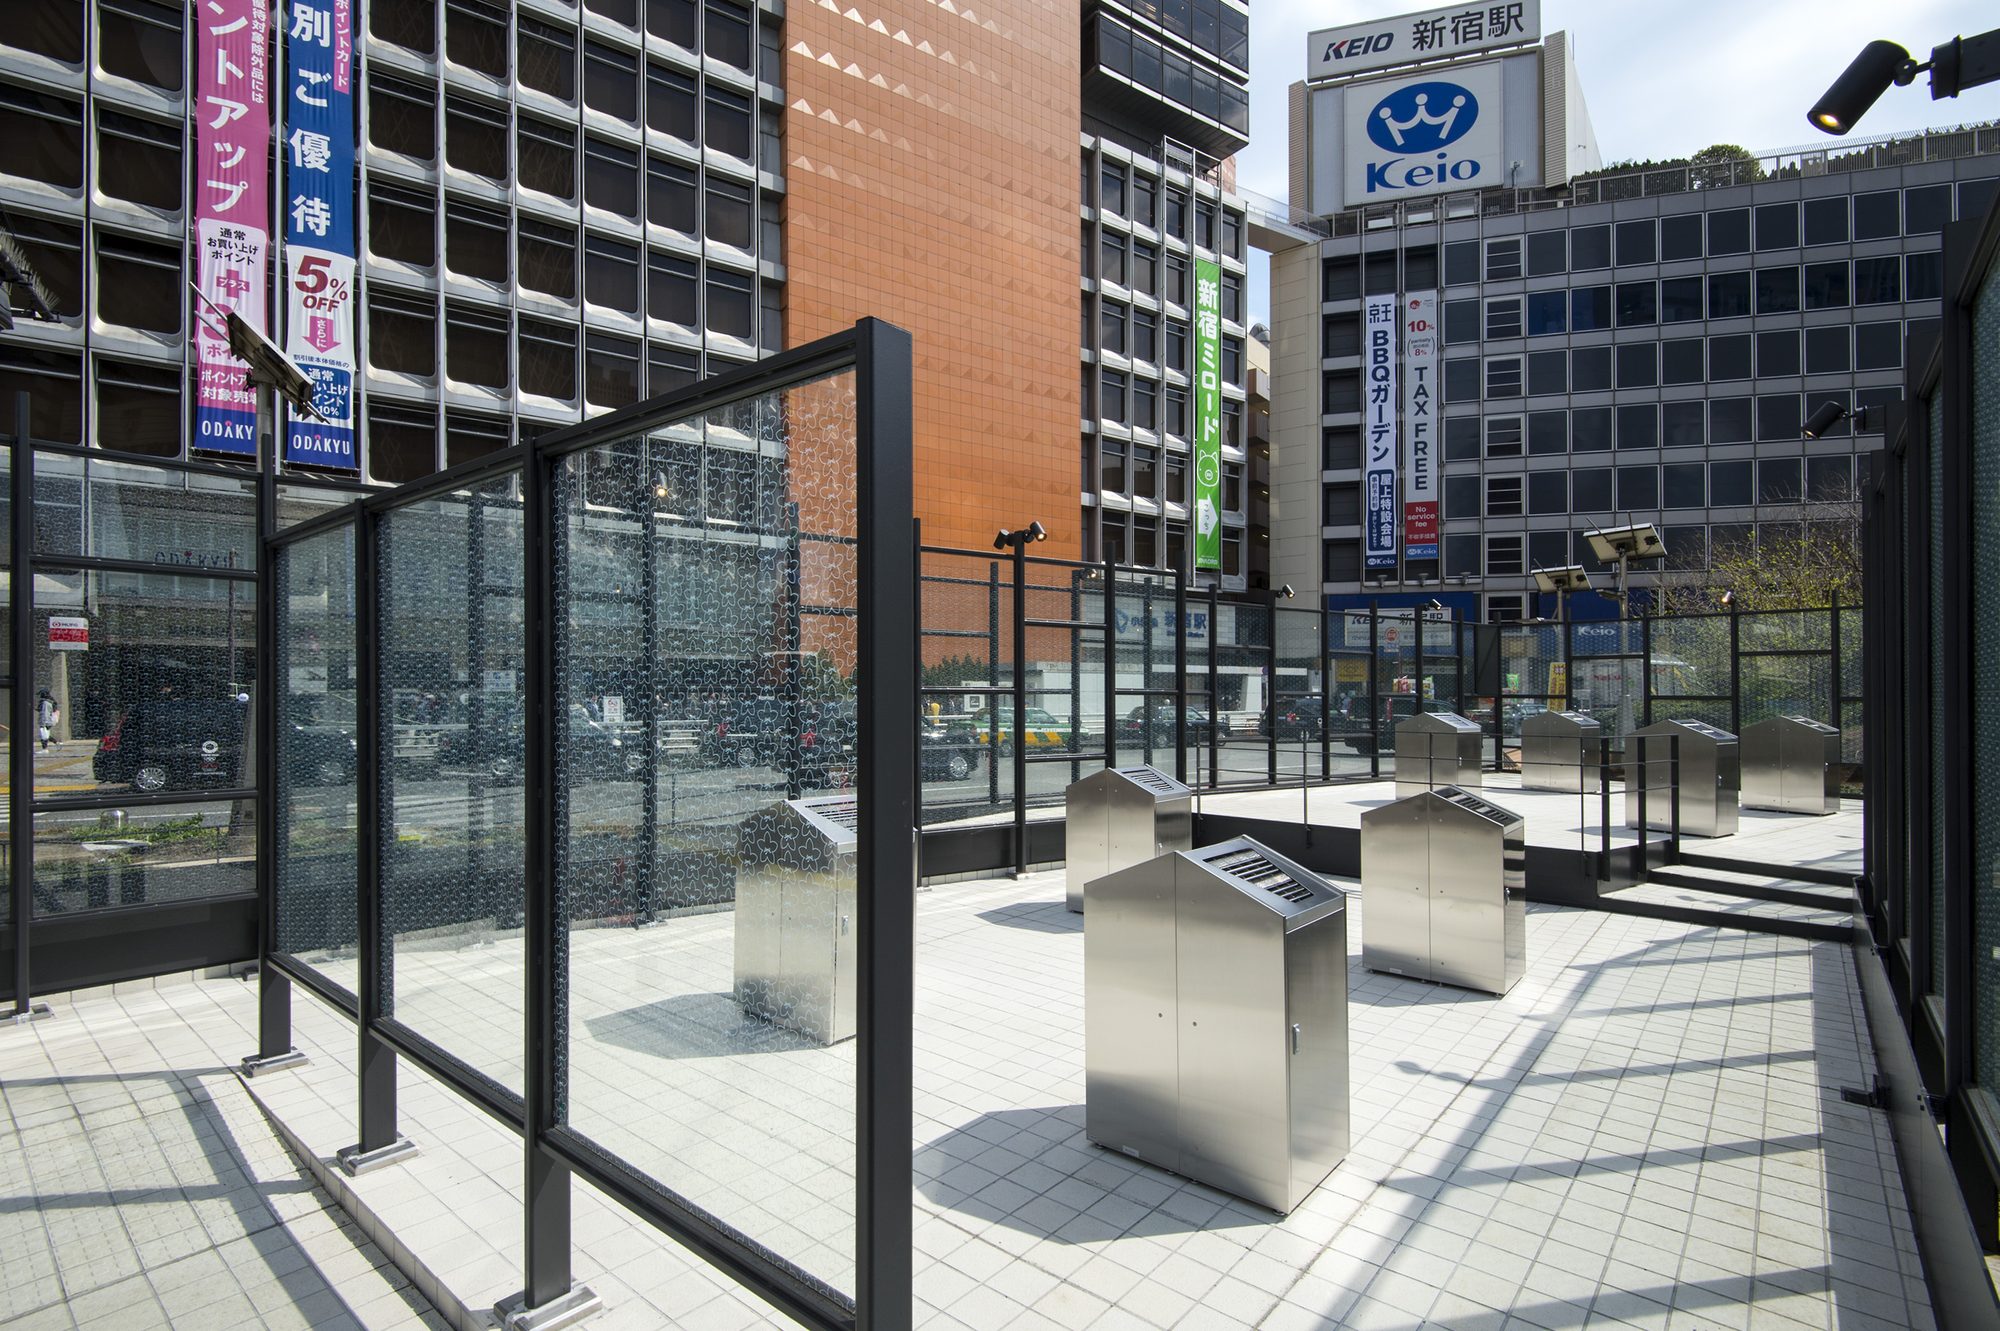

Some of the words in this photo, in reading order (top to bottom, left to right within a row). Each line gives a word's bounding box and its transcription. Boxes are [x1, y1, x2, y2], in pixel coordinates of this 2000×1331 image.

[1323, 32, 1394, 62] KEIO
[1413, 2, 1524, 51] 新宿駅
[206, 0, 249, 213] ントアップ
[289, 2, 332, 236] 別ご優待
[1366, 152, 1481, 193] Keio
[219, 226, 247, 241] 通常
[207, 236, 260, 255] お買い上げ
[211, 249, 255, 266] ポイント
[218, 278, 247, 290] プラス
[294, 255, 349, 302] 5%
[302, 295, 340, 313] OFF
[1407, 320, 1435, 333] 10%
[207, 343, 232, 360] ポイ
[1198, 278, 1219, 442] 新宿ミロード
[202, 369, 246, 386] ポイントア
[308, 367, 334, 382] 通常
[313, 382, 349, 396] い上げ
[1413, 366, 1430, 417] TAX
[312, 393, 344, 408] イント
[202, 419, 254, 440] ODAKY
[293, 433, 350, 456] ODAKYU
[1414, 422, 1429, 491] FREE
[1380, 473, 1393, 548] 屋上特設会場
[1407, 513, 1436, 521] service
[1414, 520, 1428, 528] fee
[1376, 557, 1396, 565] Keio
[1578, 626, 1616, 636] Keio
